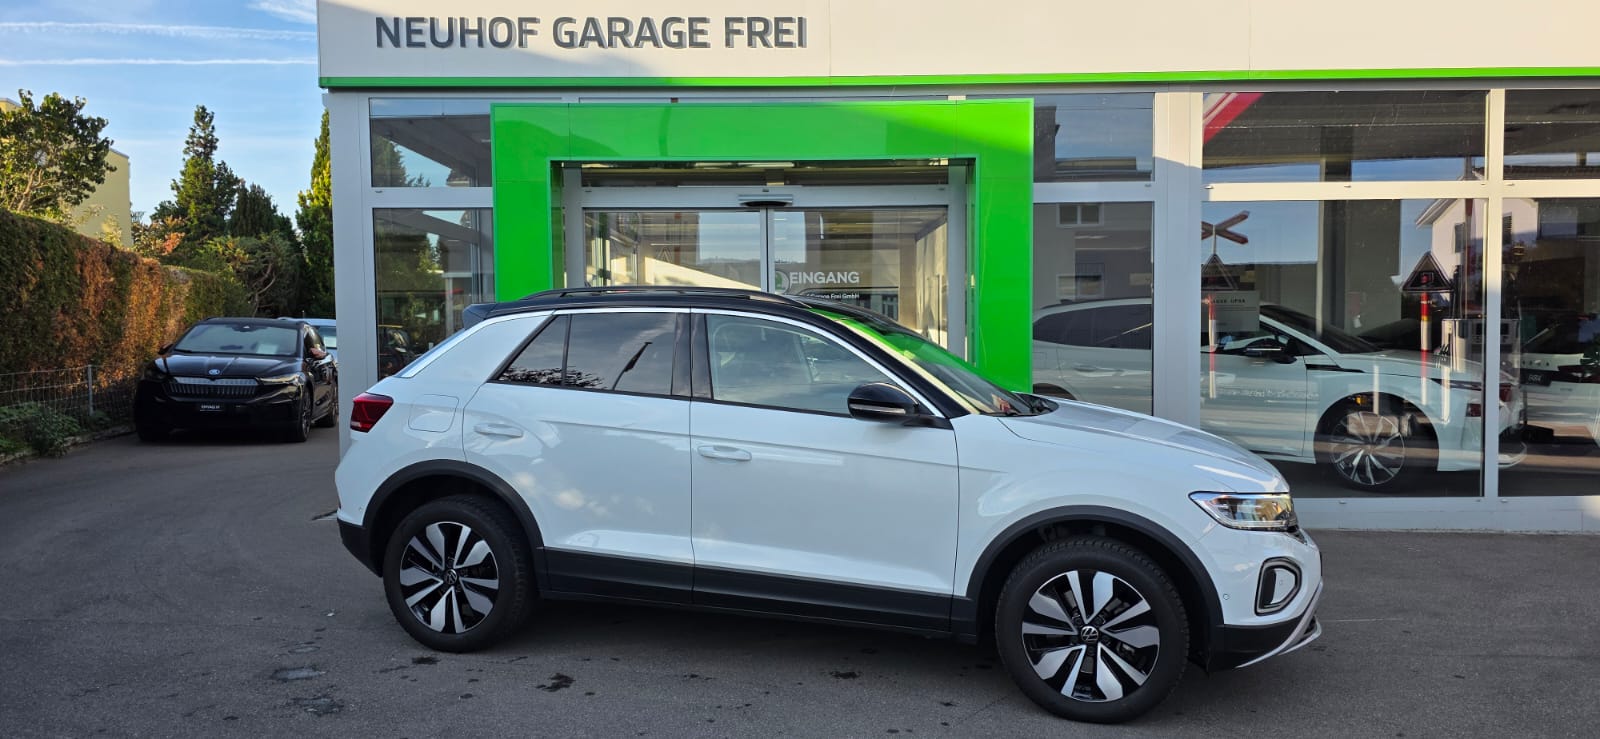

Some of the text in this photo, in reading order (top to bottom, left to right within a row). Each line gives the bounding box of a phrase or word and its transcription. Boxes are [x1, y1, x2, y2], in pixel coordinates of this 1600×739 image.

[375, 16, 807, 49] NEUHOF GARAGE FREI
[789, 271, 860, 284] EINGANG
